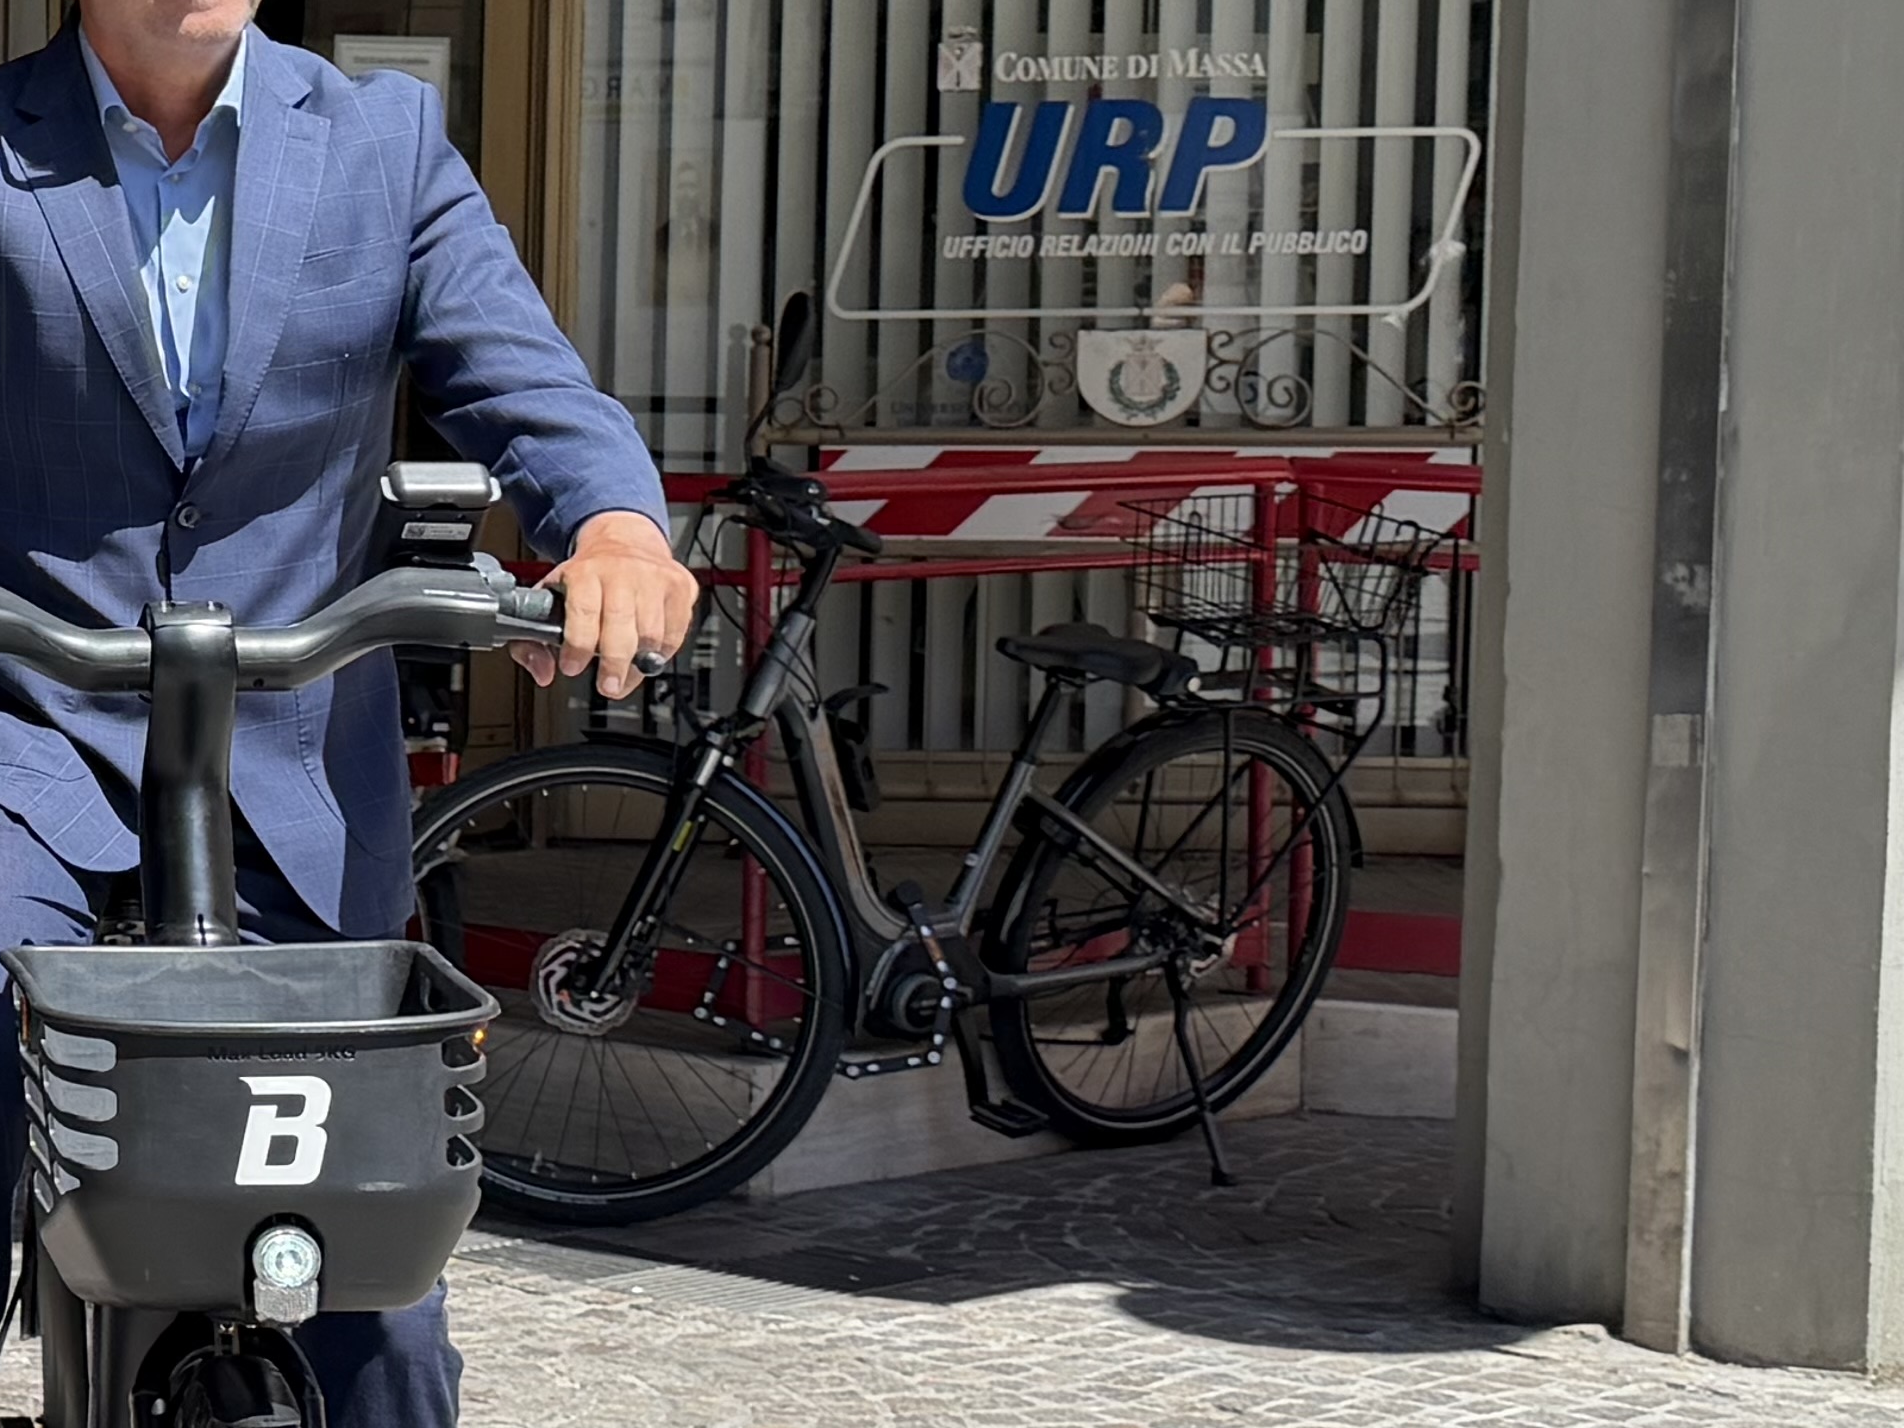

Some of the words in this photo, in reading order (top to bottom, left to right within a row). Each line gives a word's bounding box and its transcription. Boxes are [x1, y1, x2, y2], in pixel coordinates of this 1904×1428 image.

[995, 52, 1120, 83] COMUNE
[1127, 55, 1160, 79] DI
[1165, 47, 1268, 78] MASSA
[962, 96, 1269, 222] URP
[943, 234, 1036, 259] UFFICIO
[1039, 233, 1161, 258] RELAZIONI
[1165, 232, 1215, 256] CON
[1220, 232, 1243, 255] IL
[1248, 229, 1368, 256] PUBBLICO
[235, 1075, 332, 1185] B
